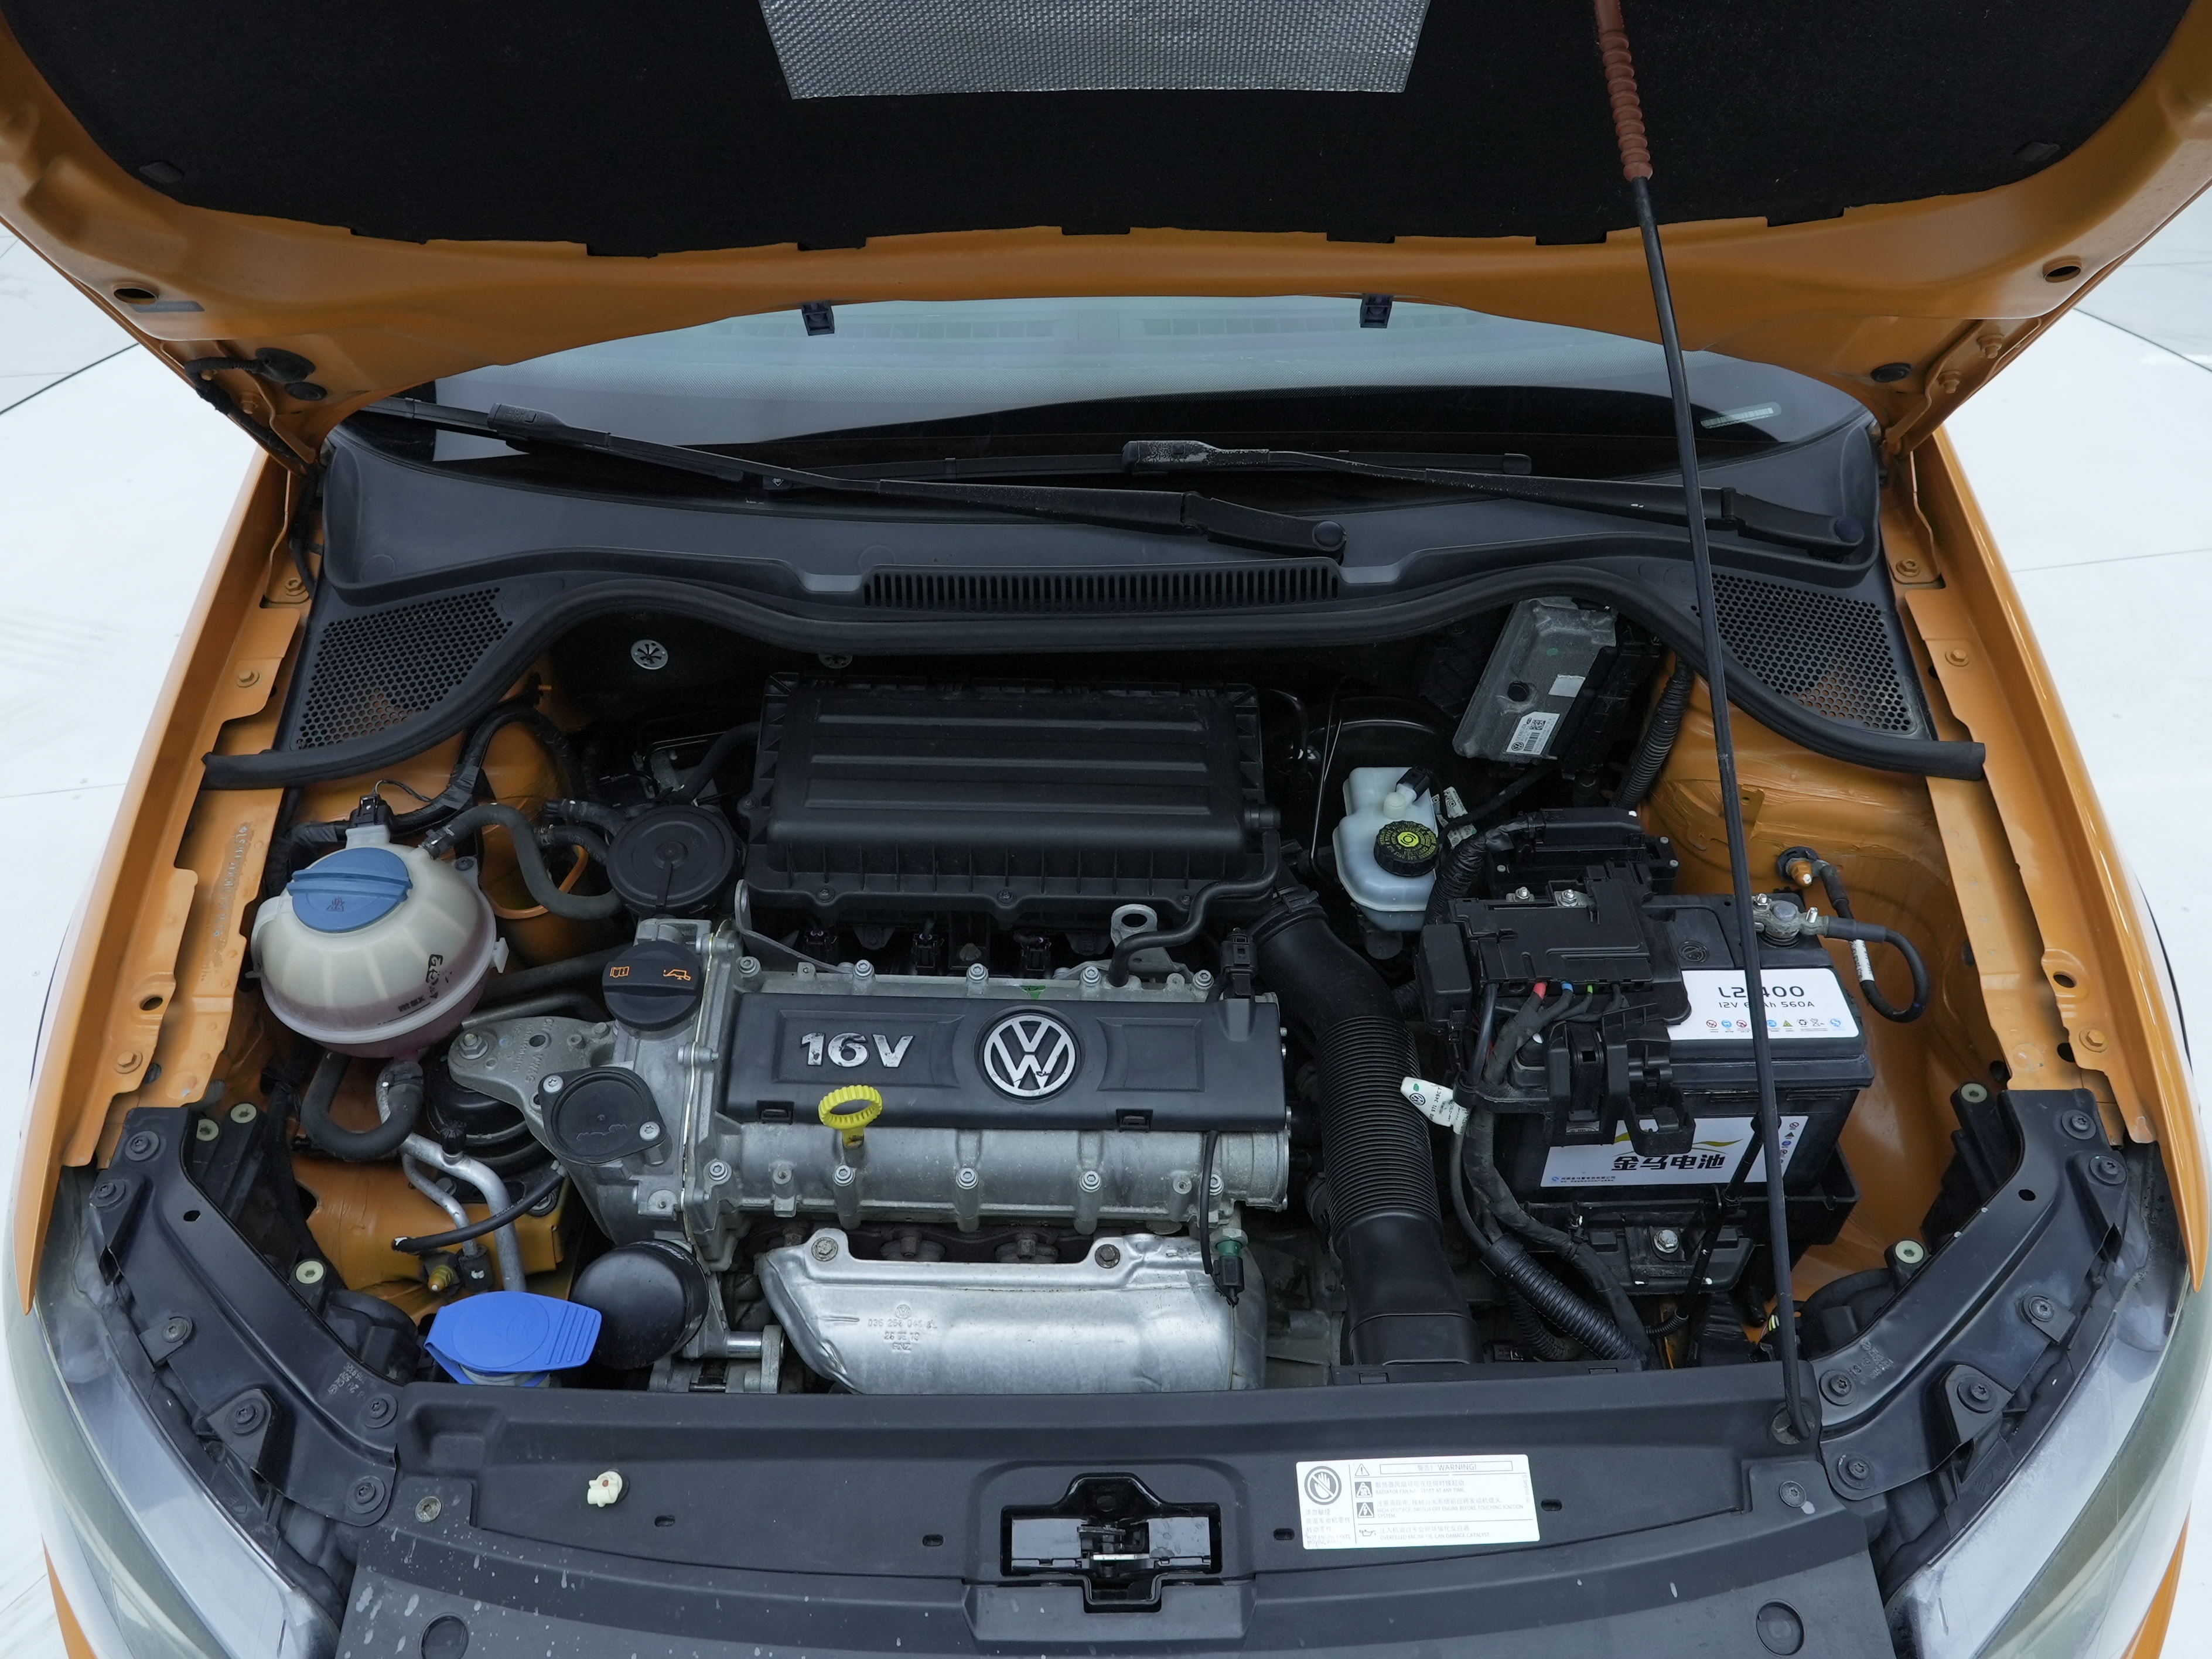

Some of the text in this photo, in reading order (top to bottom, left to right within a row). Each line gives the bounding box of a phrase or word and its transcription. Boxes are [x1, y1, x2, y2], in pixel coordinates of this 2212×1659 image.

[800, 1032, 914, 1069] 16V
[1611, 1153, 1725, 1171] 金马电池
